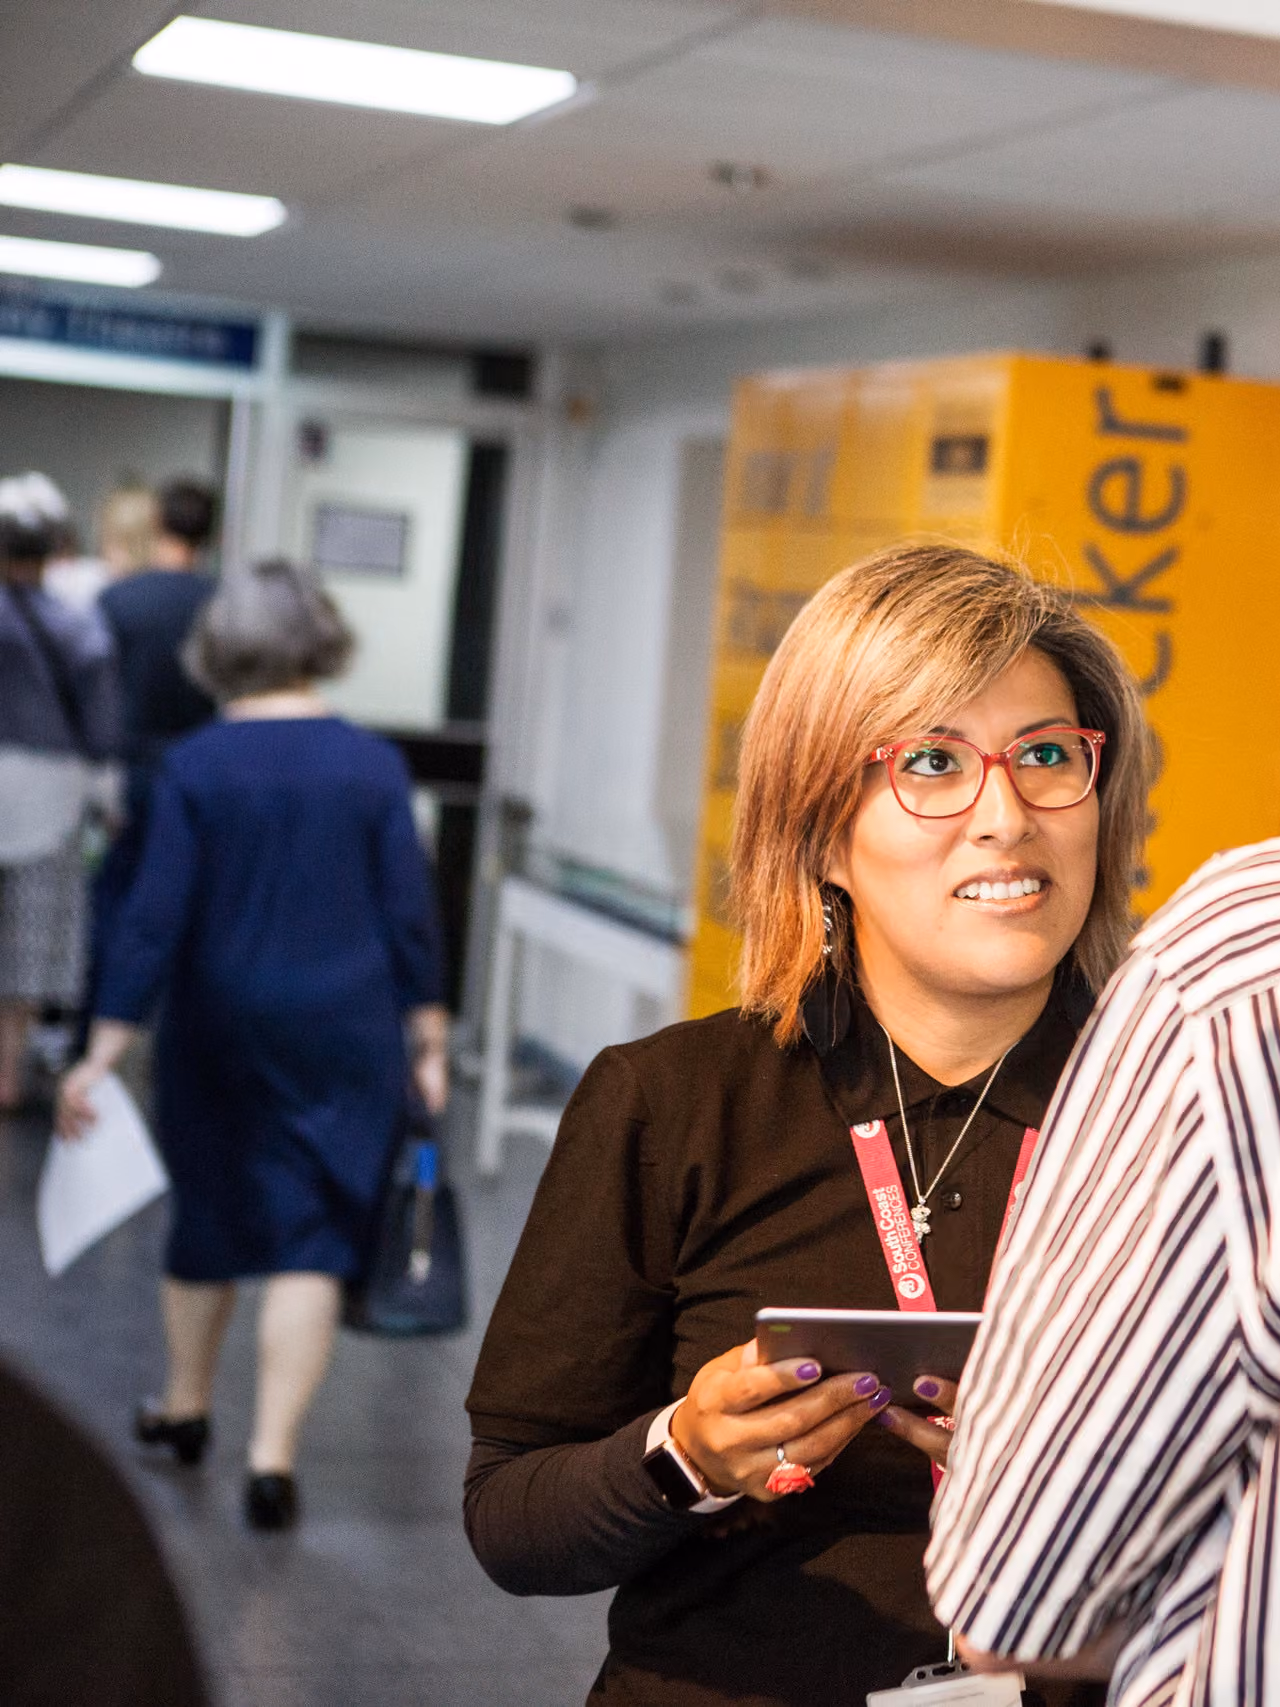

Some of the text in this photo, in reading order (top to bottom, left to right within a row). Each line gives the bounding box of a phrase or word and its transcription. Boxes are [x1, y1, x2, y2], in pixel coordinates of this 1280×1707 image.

[872, 1187, 907, 1273] South Coast
[886, 1184, 920, 1270] CONFERENCES
